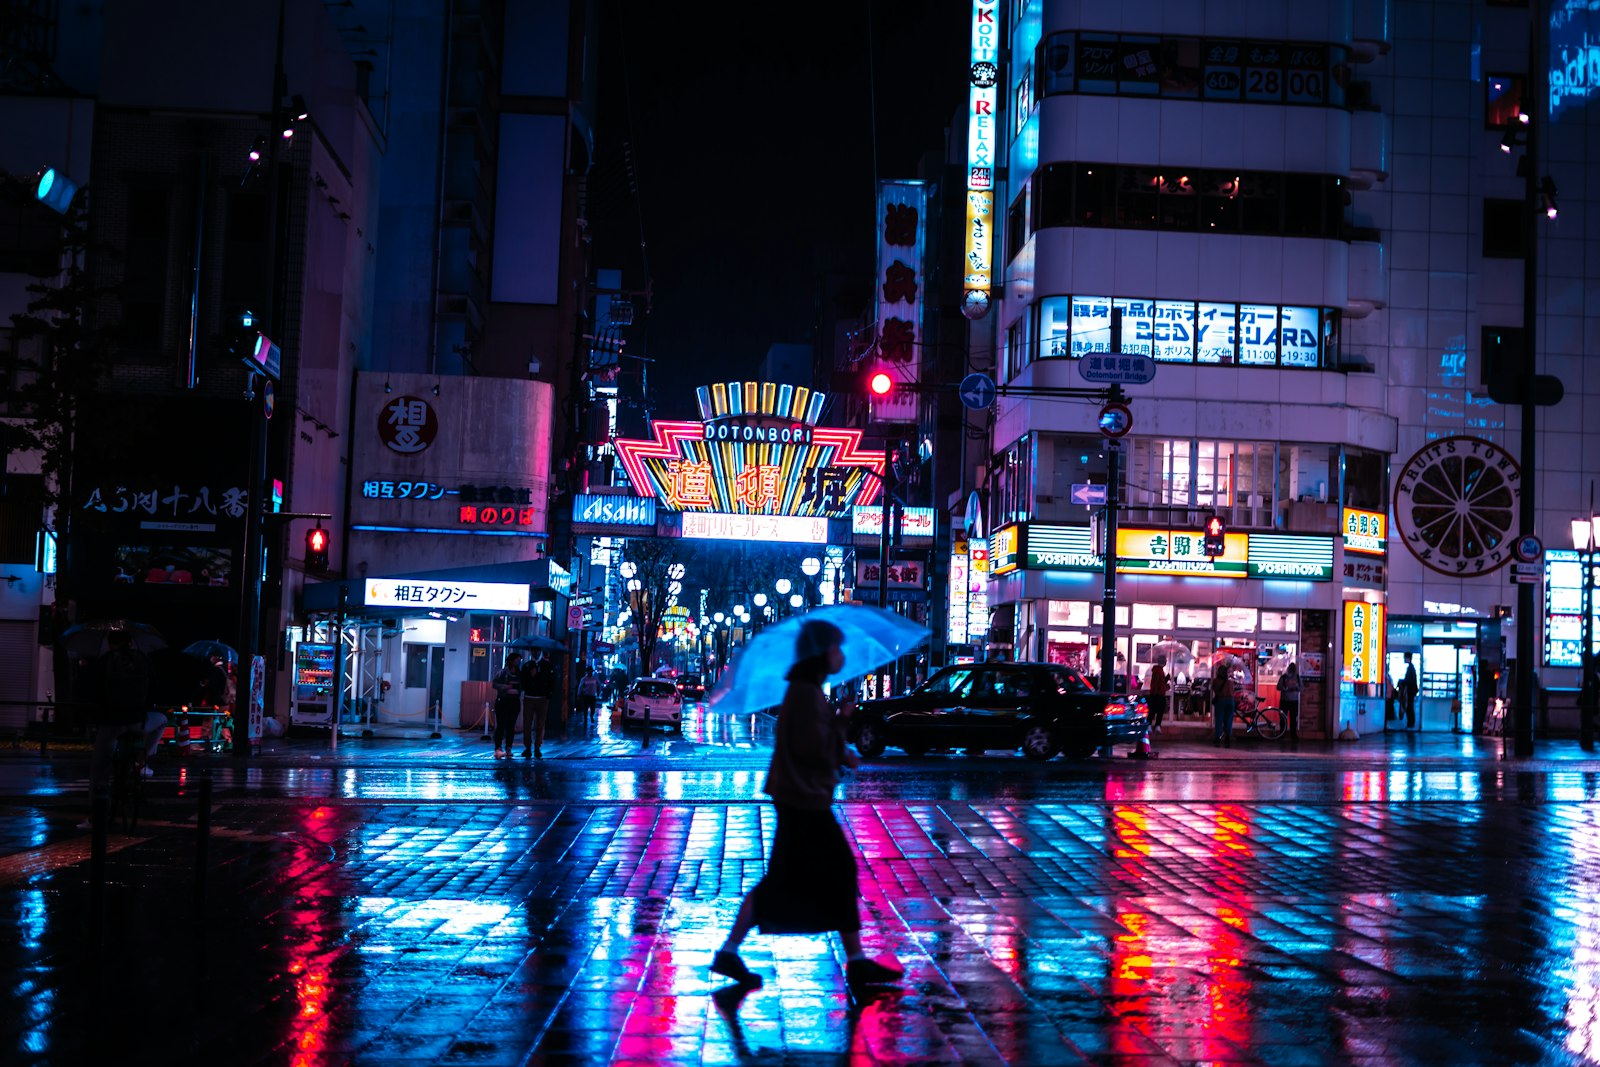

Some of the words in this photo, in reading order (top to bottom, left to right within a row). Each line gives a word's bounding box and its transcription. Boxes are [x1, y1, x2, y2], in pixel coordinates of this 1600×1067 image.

[978, 8, 993, 59] KORI
[1208, 46, 1239, 63] 全身
[1249, 48, 1280, 63] もみ
[972, 168, 990, 179] 24H
[1136, 321, 1209, 342] BODY
[1228, 326, 1317, 348] GUARD
[1089, 357, 1146, 372] 道頓堀橋
[1125, 371, 1148, 381] Bridge
[706, 425, 810, 442] DOTONBORI
[1400, 441, 1457, 495] FRUITS
[667, 460, 847, 511] 道頓堀
[459, 505, 535, 525] 南のりば
[583, 497, 646, 521] Asahi
[857, 513, 931, 527] アサビール
[1348, 514, 1379, 536] 吉野家
[1257, 563, 1324, 576] YOSHINOYA
[394, 585, 478, 603] 相互タクシー
[1352, 606, 1364, 680] 吉野家
